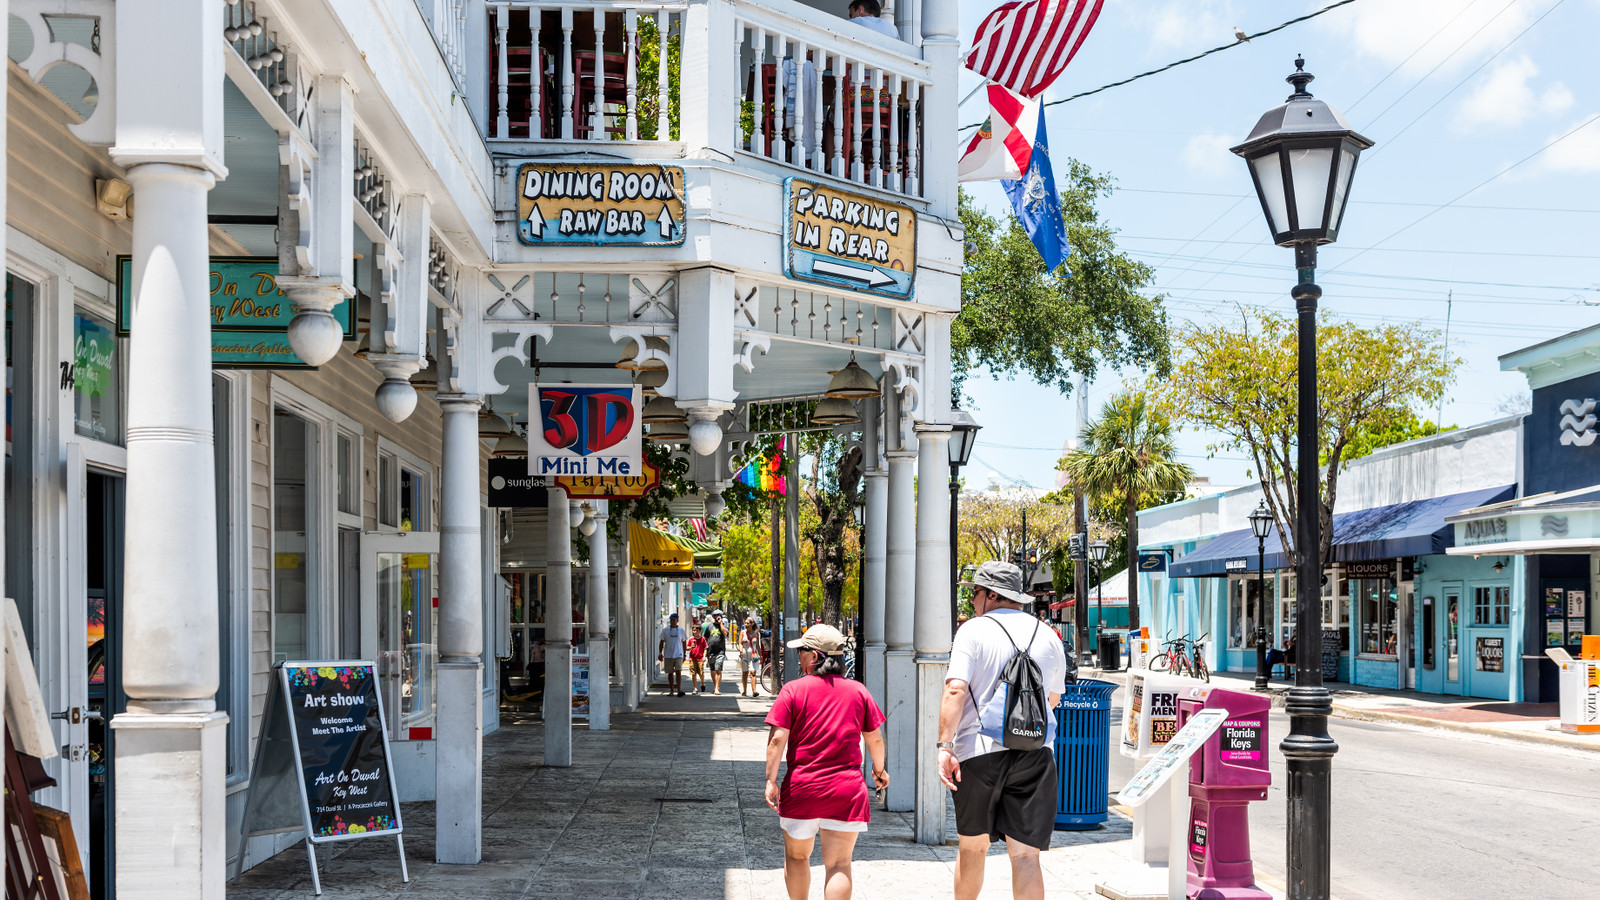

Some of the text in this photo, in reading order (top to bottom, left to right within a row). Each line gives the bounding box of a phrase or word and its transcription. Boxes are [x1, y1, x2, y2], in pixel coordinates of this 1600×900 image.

[1034, 139, 1050, 157] CONC
[523, 169, 675, 201] DINING ROOM
[796, 187, 899, 237] PARKING
[559, 208, 645, 236] RAW BAR
[794, 220, 890, 264] IN REAR
[250, 272, 288, 296] Du
[210, 298, 280, 323] ey West
[253, 342, 299, 357] Galler
[541, 390, 634, 452] 3D
[541, 457, 630, 475] Mini Me
[507, 476, 545, 490] sunglas
[700, 571, 721, 579] WORLD
[1347, 564, 1388, 573] LIQUORS
[1481, 647, 1503, 659] LIQUORS
[304, 693, 365, 708] Art show
[1063, 701, 1091, 709] Recycle
[1151, 693, 1177, 706] FR
[1151, 707, 1177, 715] MEN
[320, 717, 354, 725] Welcome
[312, 725, 367, 735] Meet The Artist
[1012, 728, 1043, 738] GARMIN
[1226, 728, 1256, 738] Florida
[1231, 738, 1252, 751] Keys
[314, 767, 380, 786] Art On Duval
[333, 784, 368, 799] Key West
